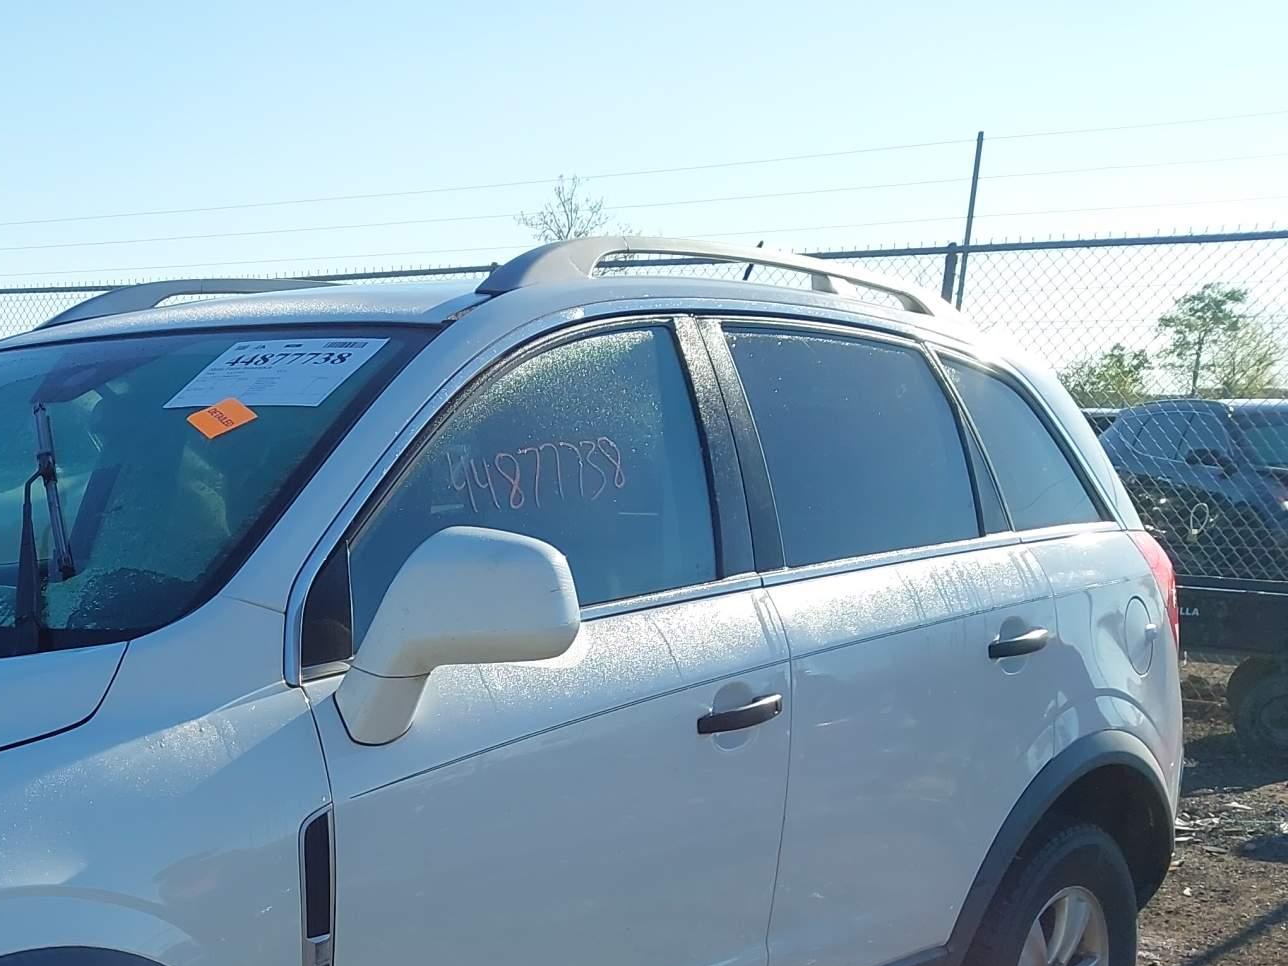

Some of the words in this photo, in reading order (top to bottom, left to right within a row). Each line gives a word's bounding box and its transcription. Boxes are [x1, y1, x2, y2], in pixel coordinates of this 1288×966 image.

[225, 352, 352, 366] 44877738
[208, 408, 234, 427] DETAILED
[447, 437, 625, 512] 44877738
